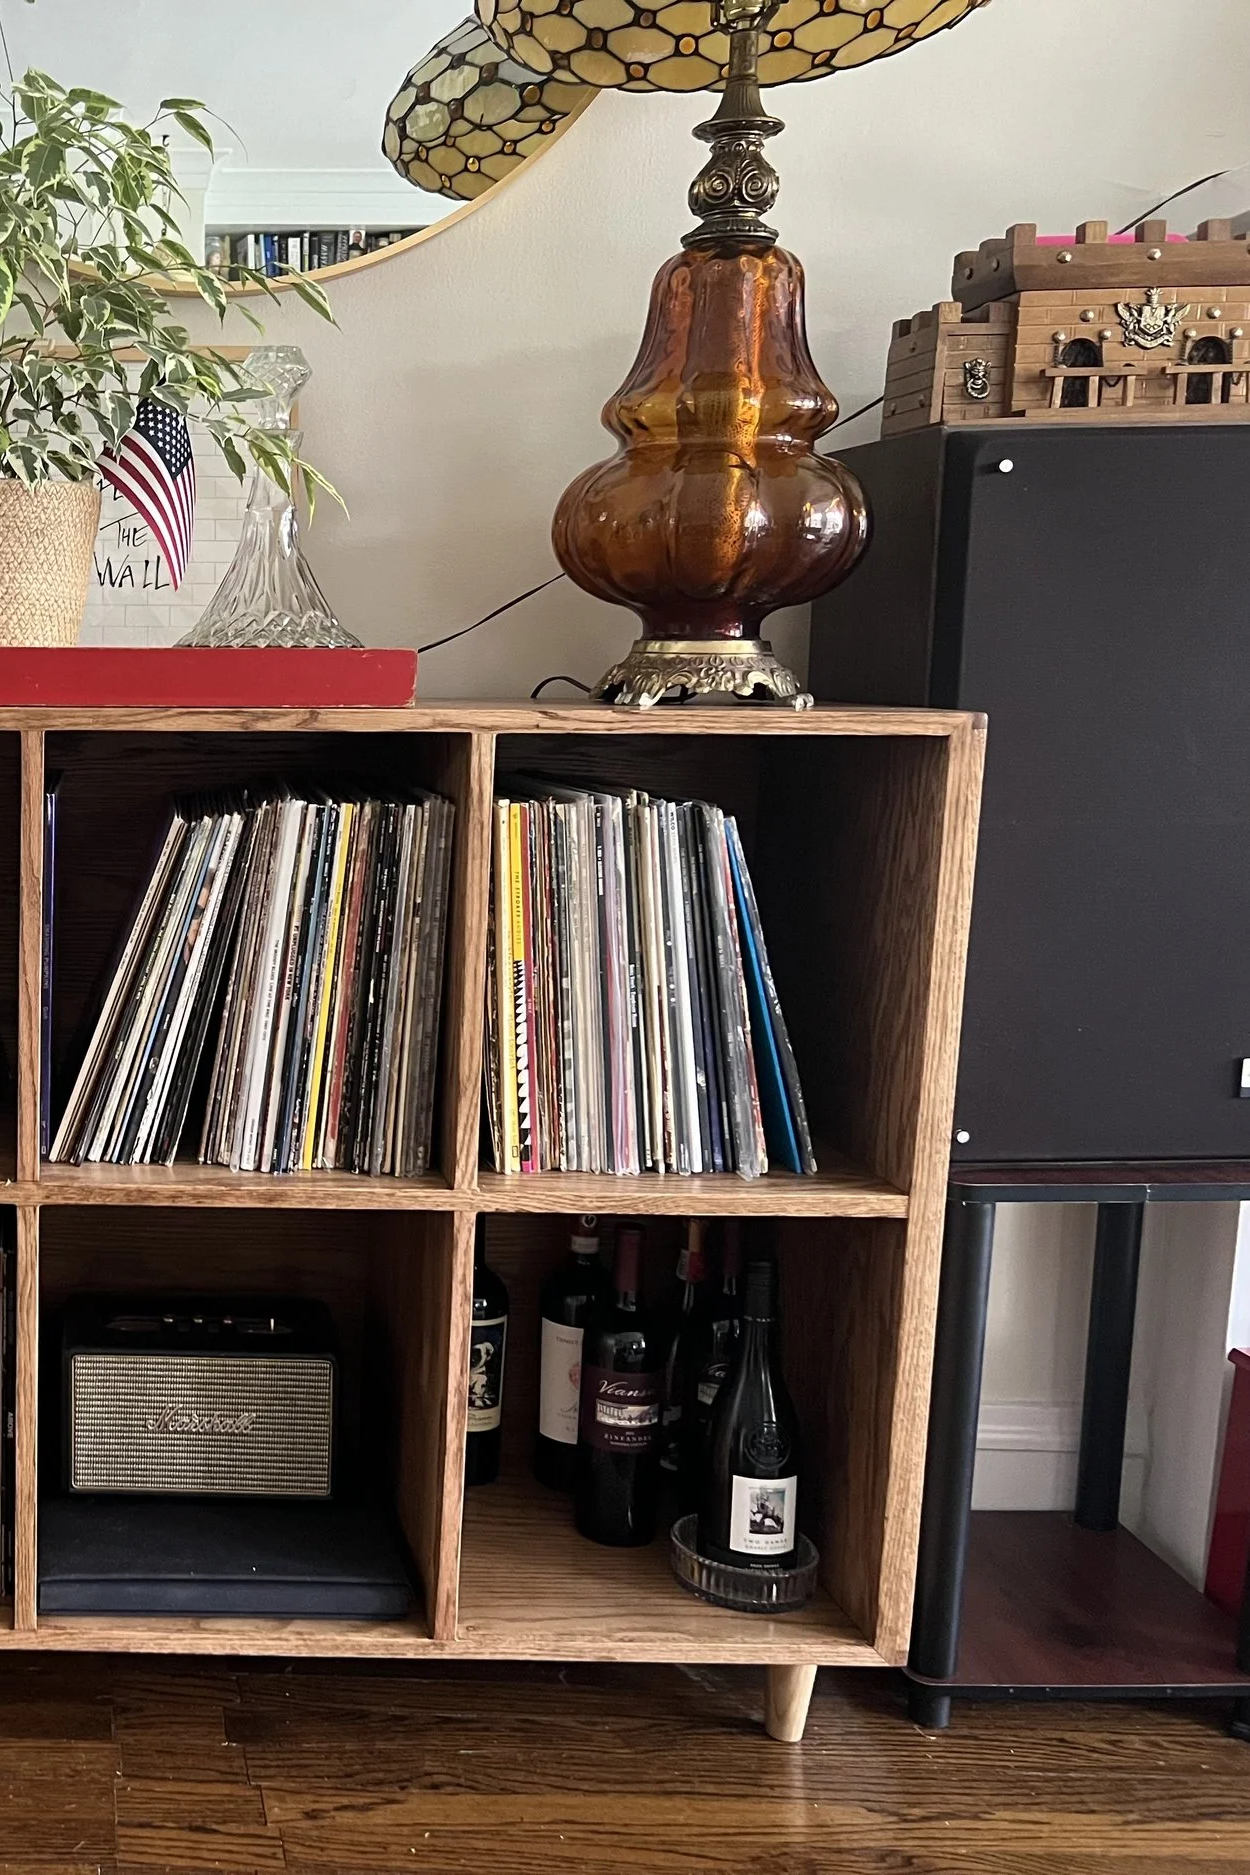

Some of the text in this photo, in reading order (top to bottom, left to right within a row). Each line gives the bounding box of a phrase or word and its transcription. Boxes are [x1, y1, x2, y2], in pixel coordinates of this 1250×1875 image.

[93, 553, 171, 590] WALL
[287, 932, 299, 966] UNPLUGGED
[283, 986, 291, 1001] YORK
[5, 1411, 15, 1438] ABOVE
[146, 1402, 256, 1434] Marshall
